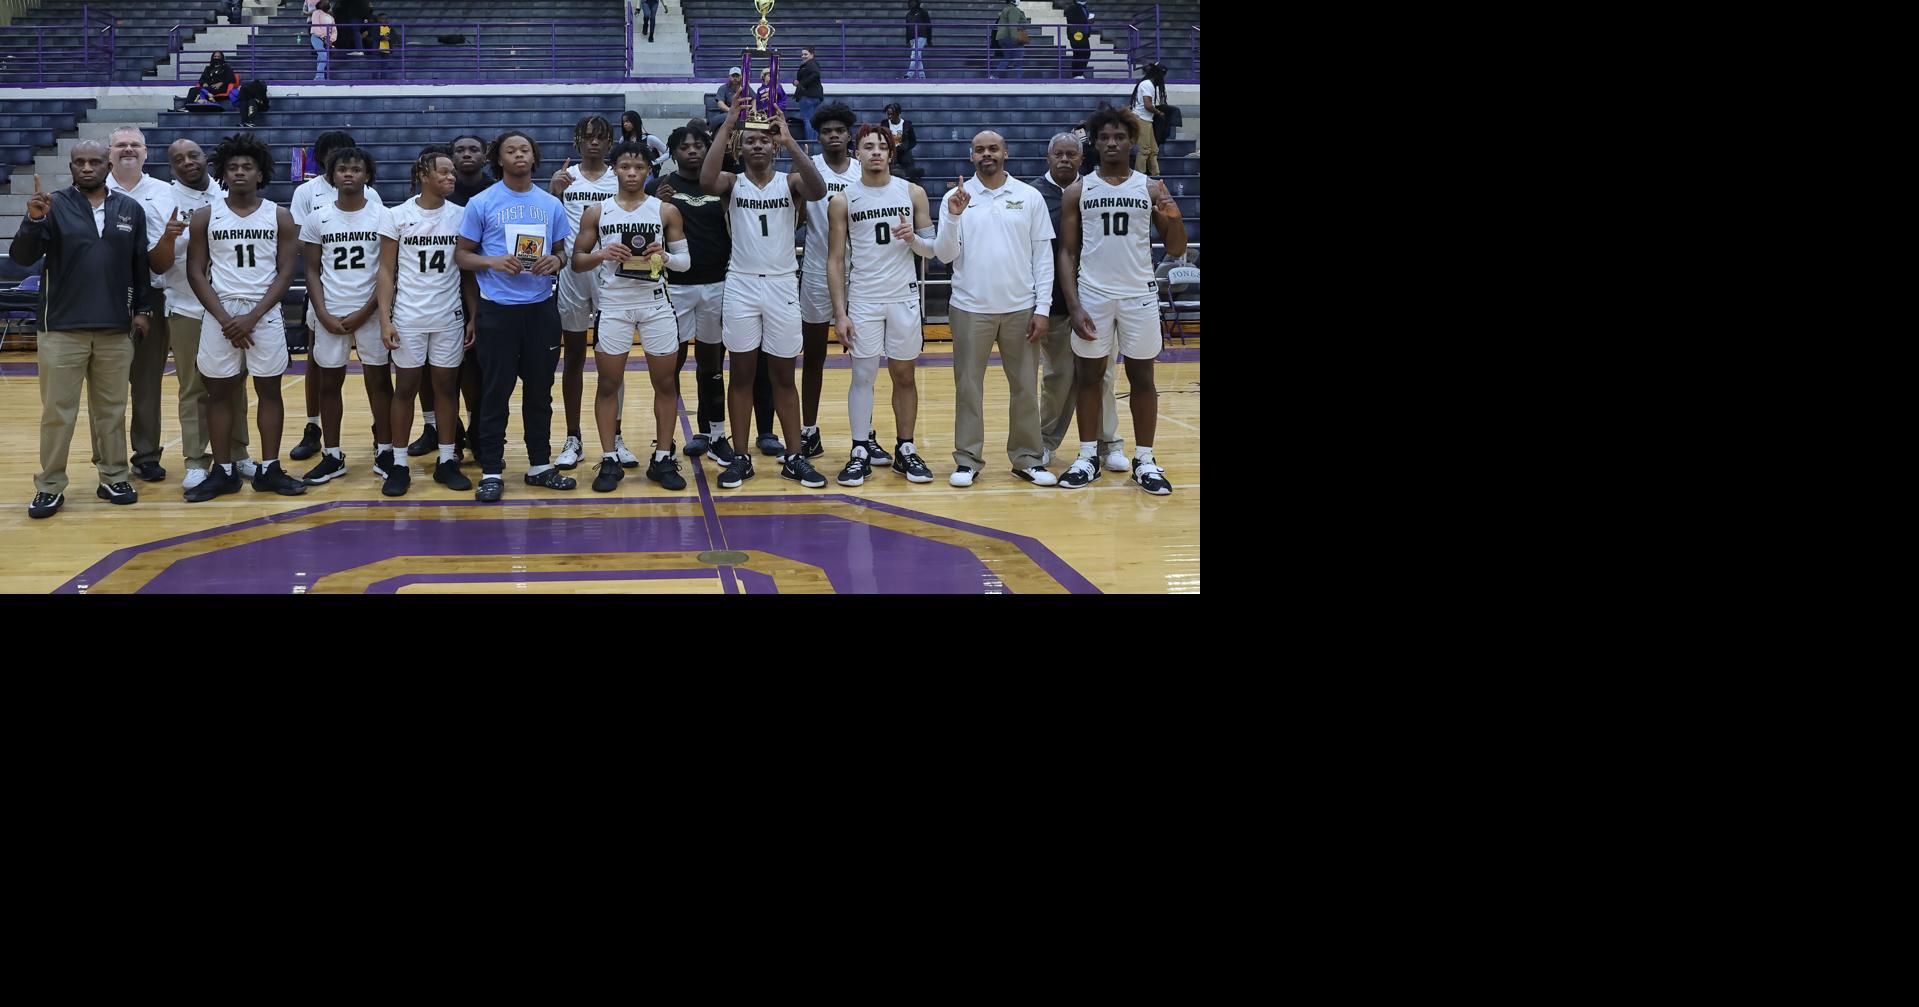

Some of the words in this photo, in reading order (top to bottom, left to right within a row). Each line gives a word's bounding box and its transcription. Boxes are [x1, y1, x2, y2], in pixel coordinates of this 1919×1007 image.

[565, 191, 617, 202] WARHAWK
[736, 197, 790, 210] WARHAWKS
[1083, 197, 1149, 210] WARHAWKS
[495, 205, 525, 229] JUST
[850, 206, 911, 222] WARHAWKS
[600, 223, 662, 236] WARHAWKS
[759, 214, 769, 237] 1
[1101, 211, 1129, 236] 10
[212, 229, 275, 240] WARHAWKS
[320, 230, 378, 244] WARHAWKS
[404, 235, 459, 246] WARHAWKS
[875, 222, 891, 245] 0
[234, 243, 256, 268] 11
[333, 245, 366, 270] 22
[418, 249, 446, 273] 14
